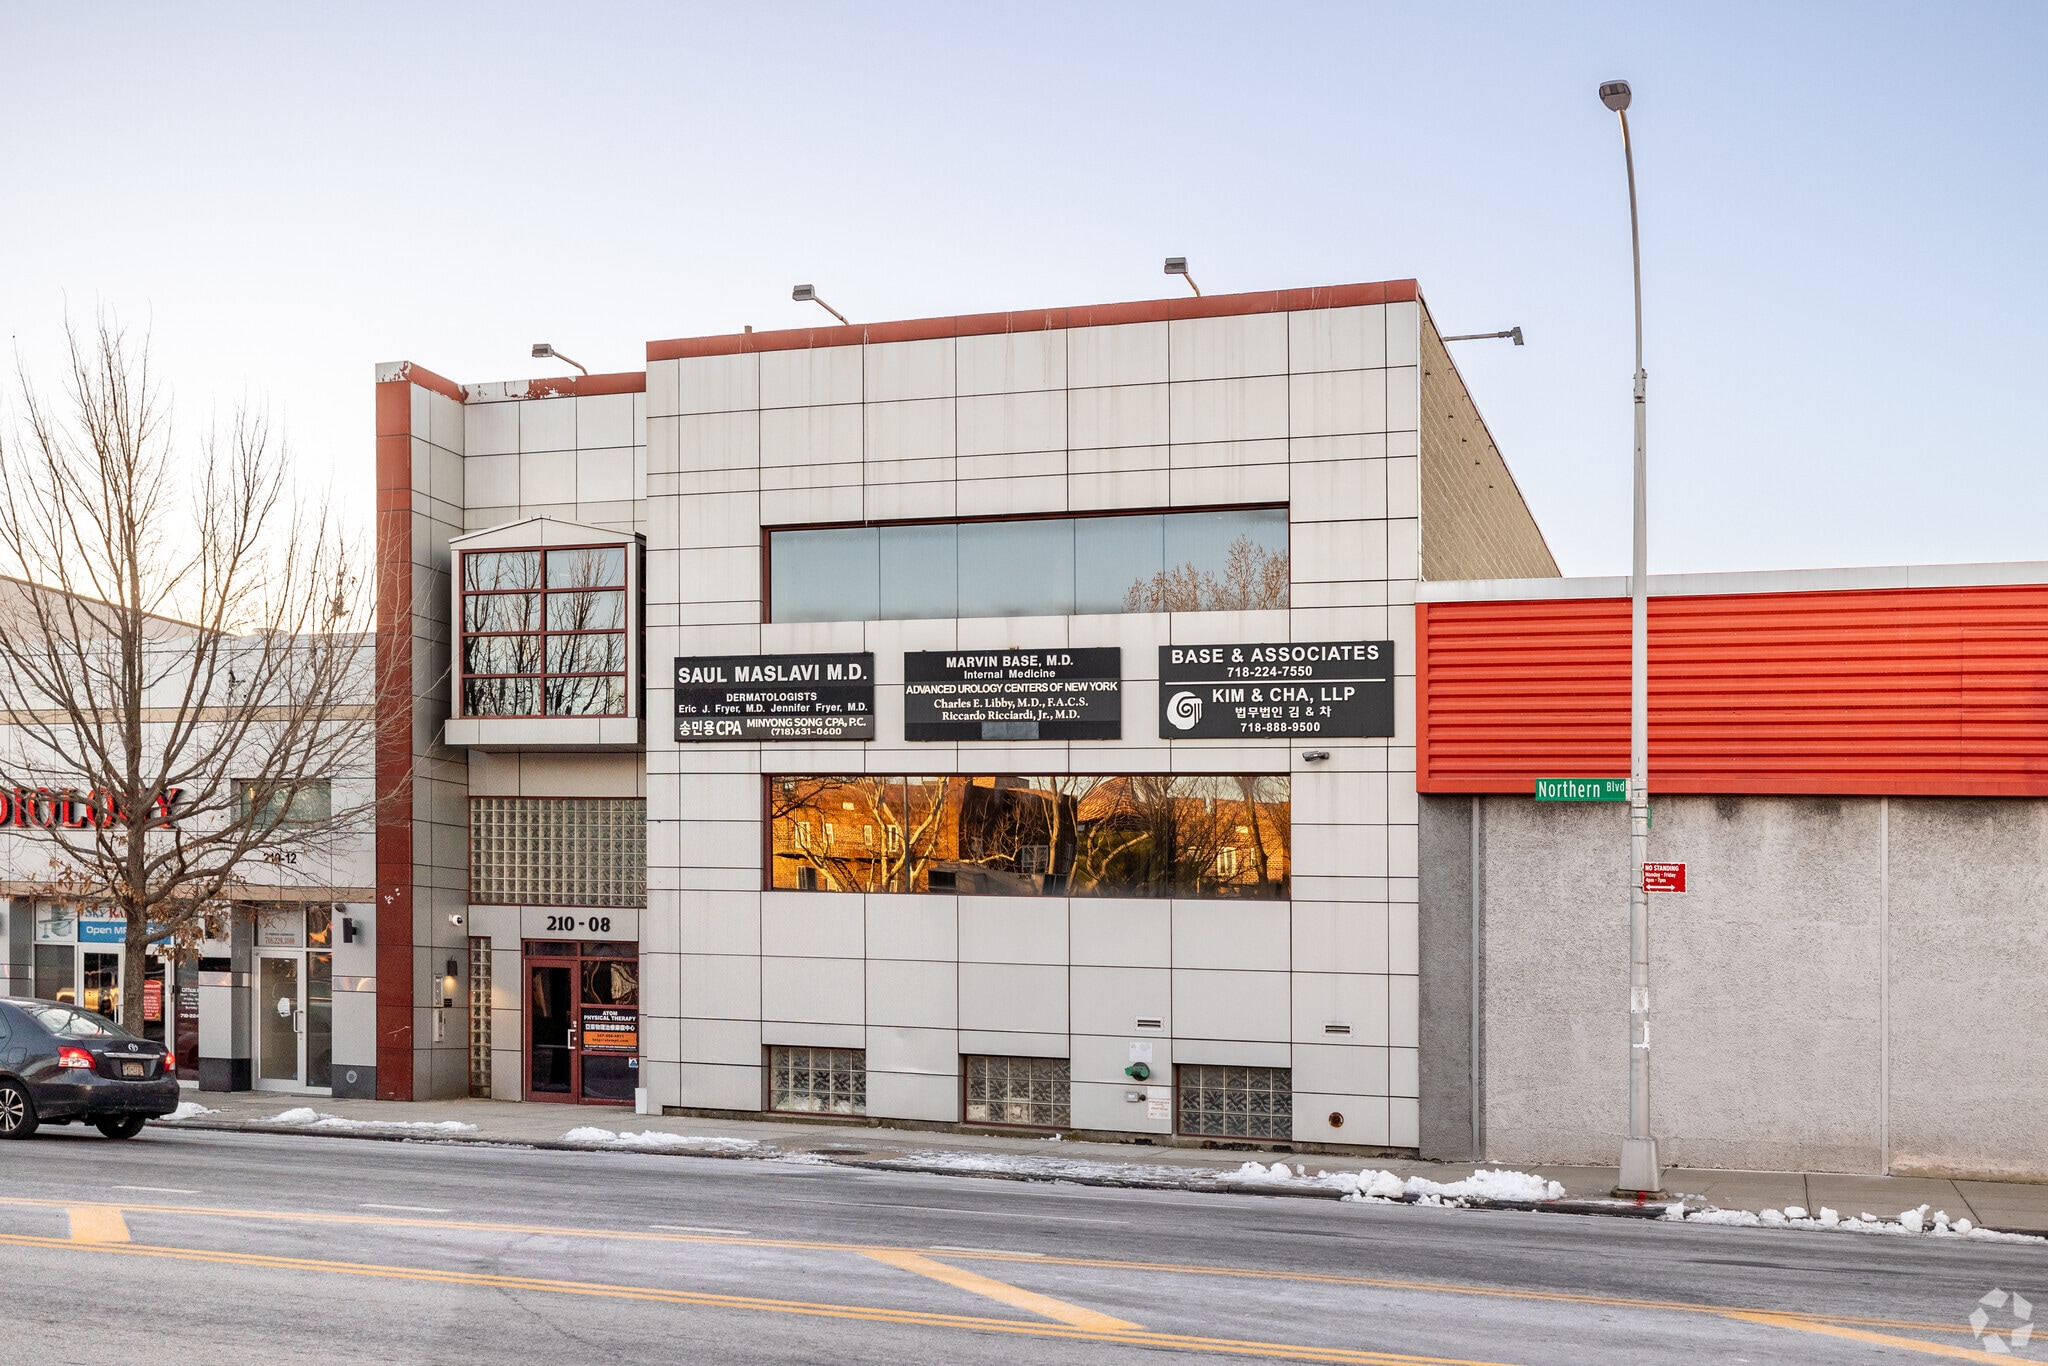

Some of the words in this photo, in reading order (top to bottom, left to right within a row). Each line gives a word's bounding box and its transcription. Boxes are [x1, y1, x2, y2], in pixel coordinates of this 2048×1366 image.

[1172, 649, 1224, 664] BASE
[1231, 648, 1244, 663] &
[1251, 645, 1379, 662] ASSOCIATES
[946, 657, 998, 668] MARVIN
[1003, 656, 1042, 668] BASE,
[1047, 655, 1074, 666] M.D.
[679, 667, 727, 683] SAUL
[735, 665, 820, 683] MASLAVI
[827, 663, 867, 681] M.D.
[964, 670, 1003, 680] Internal
[1009, 670, 1056, 679] Medicine
[1227, 666, 1313, 677] 718-224-7550
[906, 685, 956, 694] ADVANCED
[958, 684, 1003, 694] UROLOGY
[1005, 683, 1048, 693] CENTERS
[1050, 683, 1064, 692] OF
[1065, 682, 1088, 692] NEW
[1089, 682, 1118, 691] YORK
[726, 692, 818, 702] DERMATOLOGISTS
[1212, 689, 1245, 703] KIM
[1251, 688, 1263, 702] &
[1270, 687, 1313, 704] CHA,
[1321, 687, 1355, 701] LLP
[679, 704, 697, 713] Eric
[702, 705, 710, 713] J.
[715, 704, 740, 715] Fryer,
[746, 704, 765, 713] M.D.
[771, 703, 810, 713] Jennifer
[816, 703, 842, 713] Fryer,
[848, 703, 868, 711] M.D.
[934, 699, 971, 709] Charles
[973, 699, 983, 708] E.
[985, 698, 1015, 710] Libby,
[1017, 698, 1045, 709] M.D.,
[1048, 697, 1088, 707] F.A.C.S.
[942, 711, 986, 721] Riccardo
[988, 711, 1036, 721] Ricciardi,
[1037, 711, 1053, 721] Jr.,
[1055, 710, 1080, 719] M.D.
[1235, 707, 1283, 718] 법무법인
[1289, 707, 1300, 718] 김
[1306, 707, 1314, 716] &
[1320, 706, 1331, 718] 차
[747, 718, 793, 728] MINYONG
[795, 718, 823, 727] SONG
[826, 718, 847, 728] CPA,
[849, 718, 866, 727] P.C.
[1241, 722, 1321, 732] 718-888-9500
[771, 728, 842, 736] (718)631-0600
[1538, 781, 1600, 798] Northern
[1607, 782, 1625, 792] Blvd
[0, 787, 184, 829] IOLOY
[86, 906, 106, 918] SKY
[86, 926, 112, 935] Open
